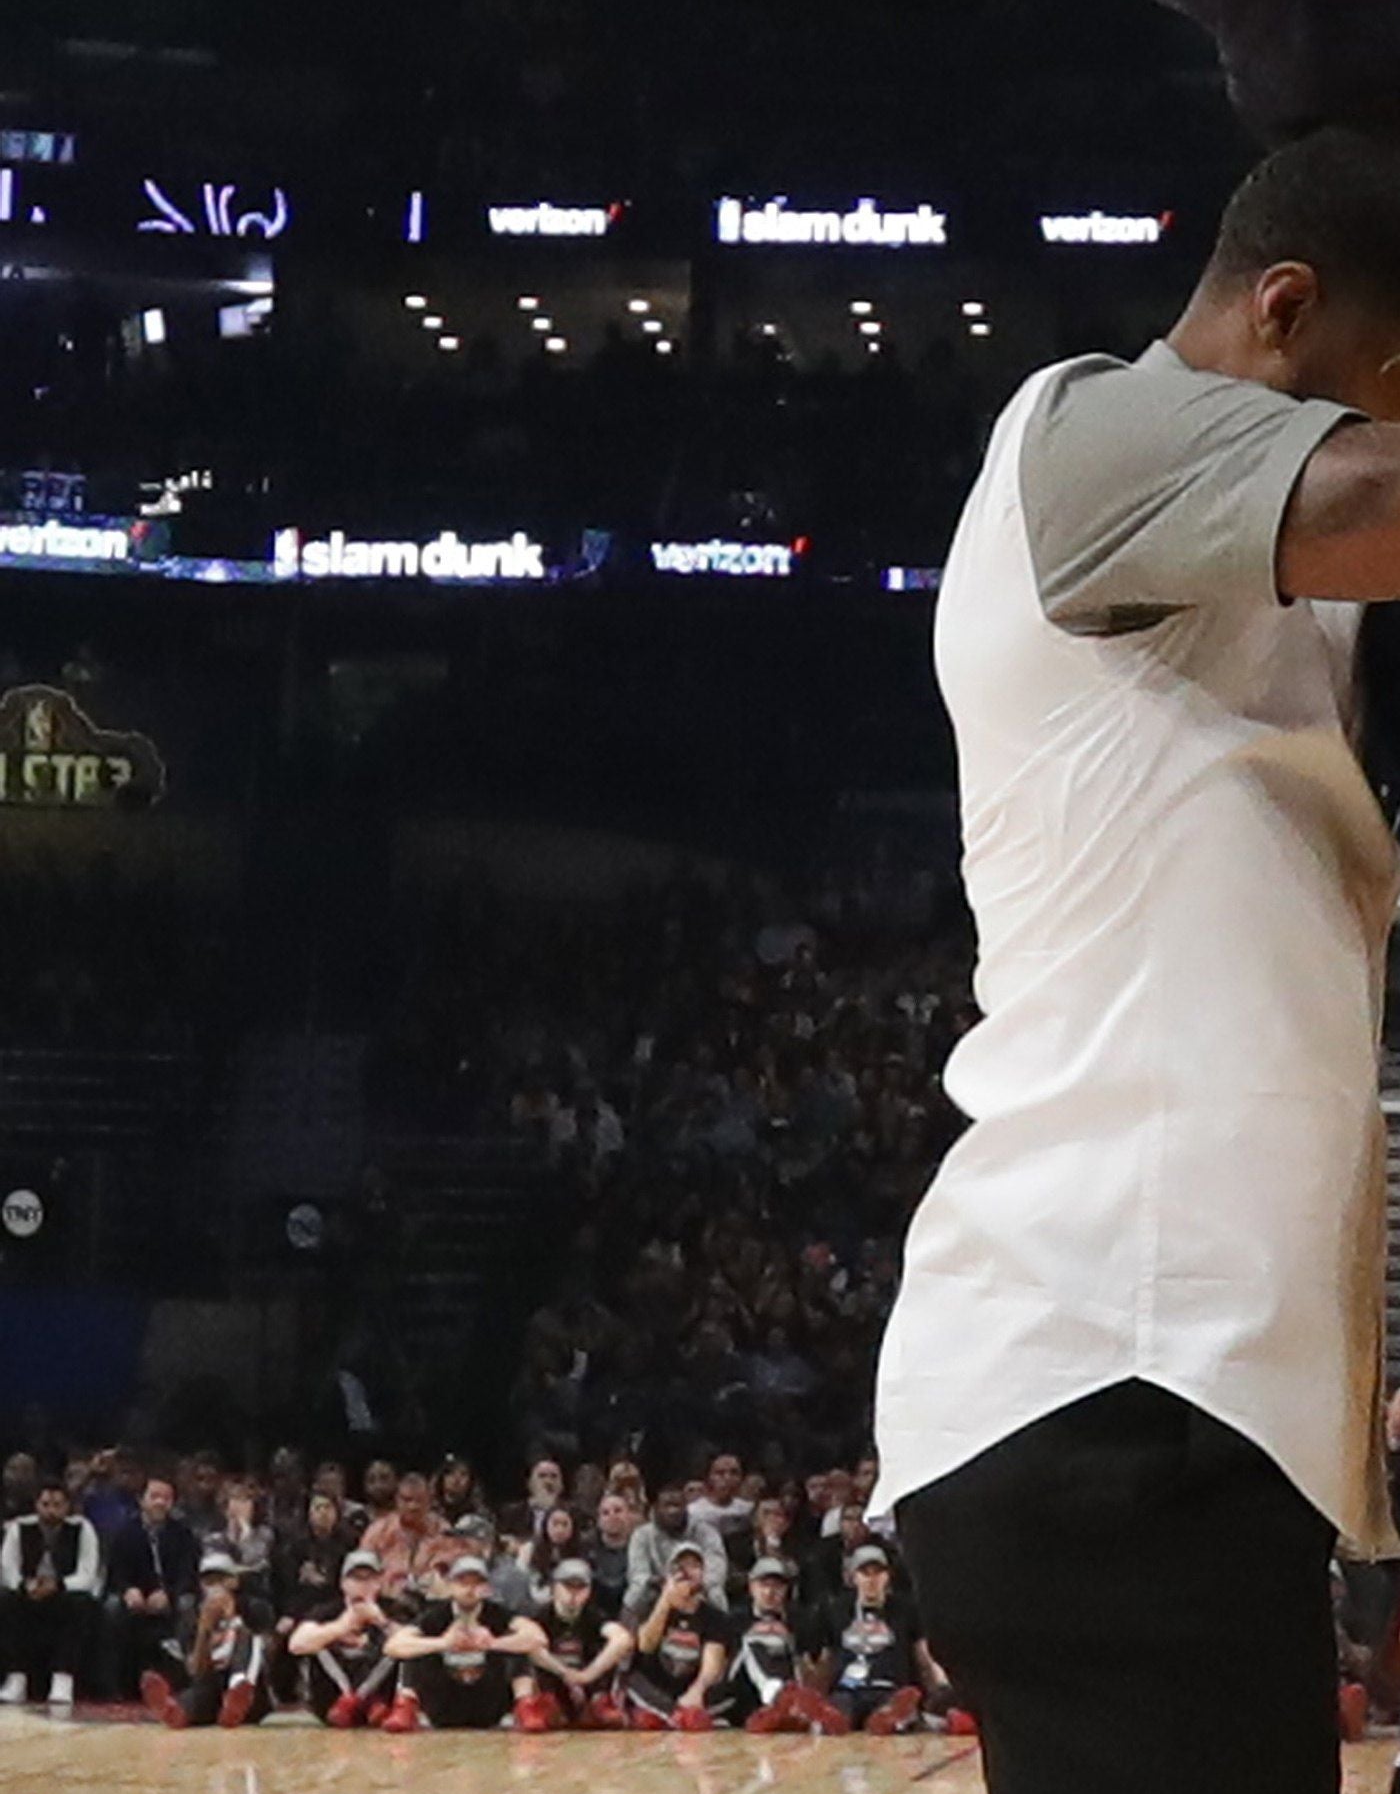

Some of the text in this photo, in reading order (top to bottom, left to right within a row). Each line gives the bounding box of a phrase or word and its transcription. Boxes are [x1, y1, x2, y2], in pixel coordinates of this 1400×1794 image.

[488, 202, 606, 236] verizon
[742, 200, 947, 244] slam dunk
[1040, 210, 1159, 243] verizon
[302, 530, 545, 579] slam dunk
[650, 538, 790, 575] verizon
